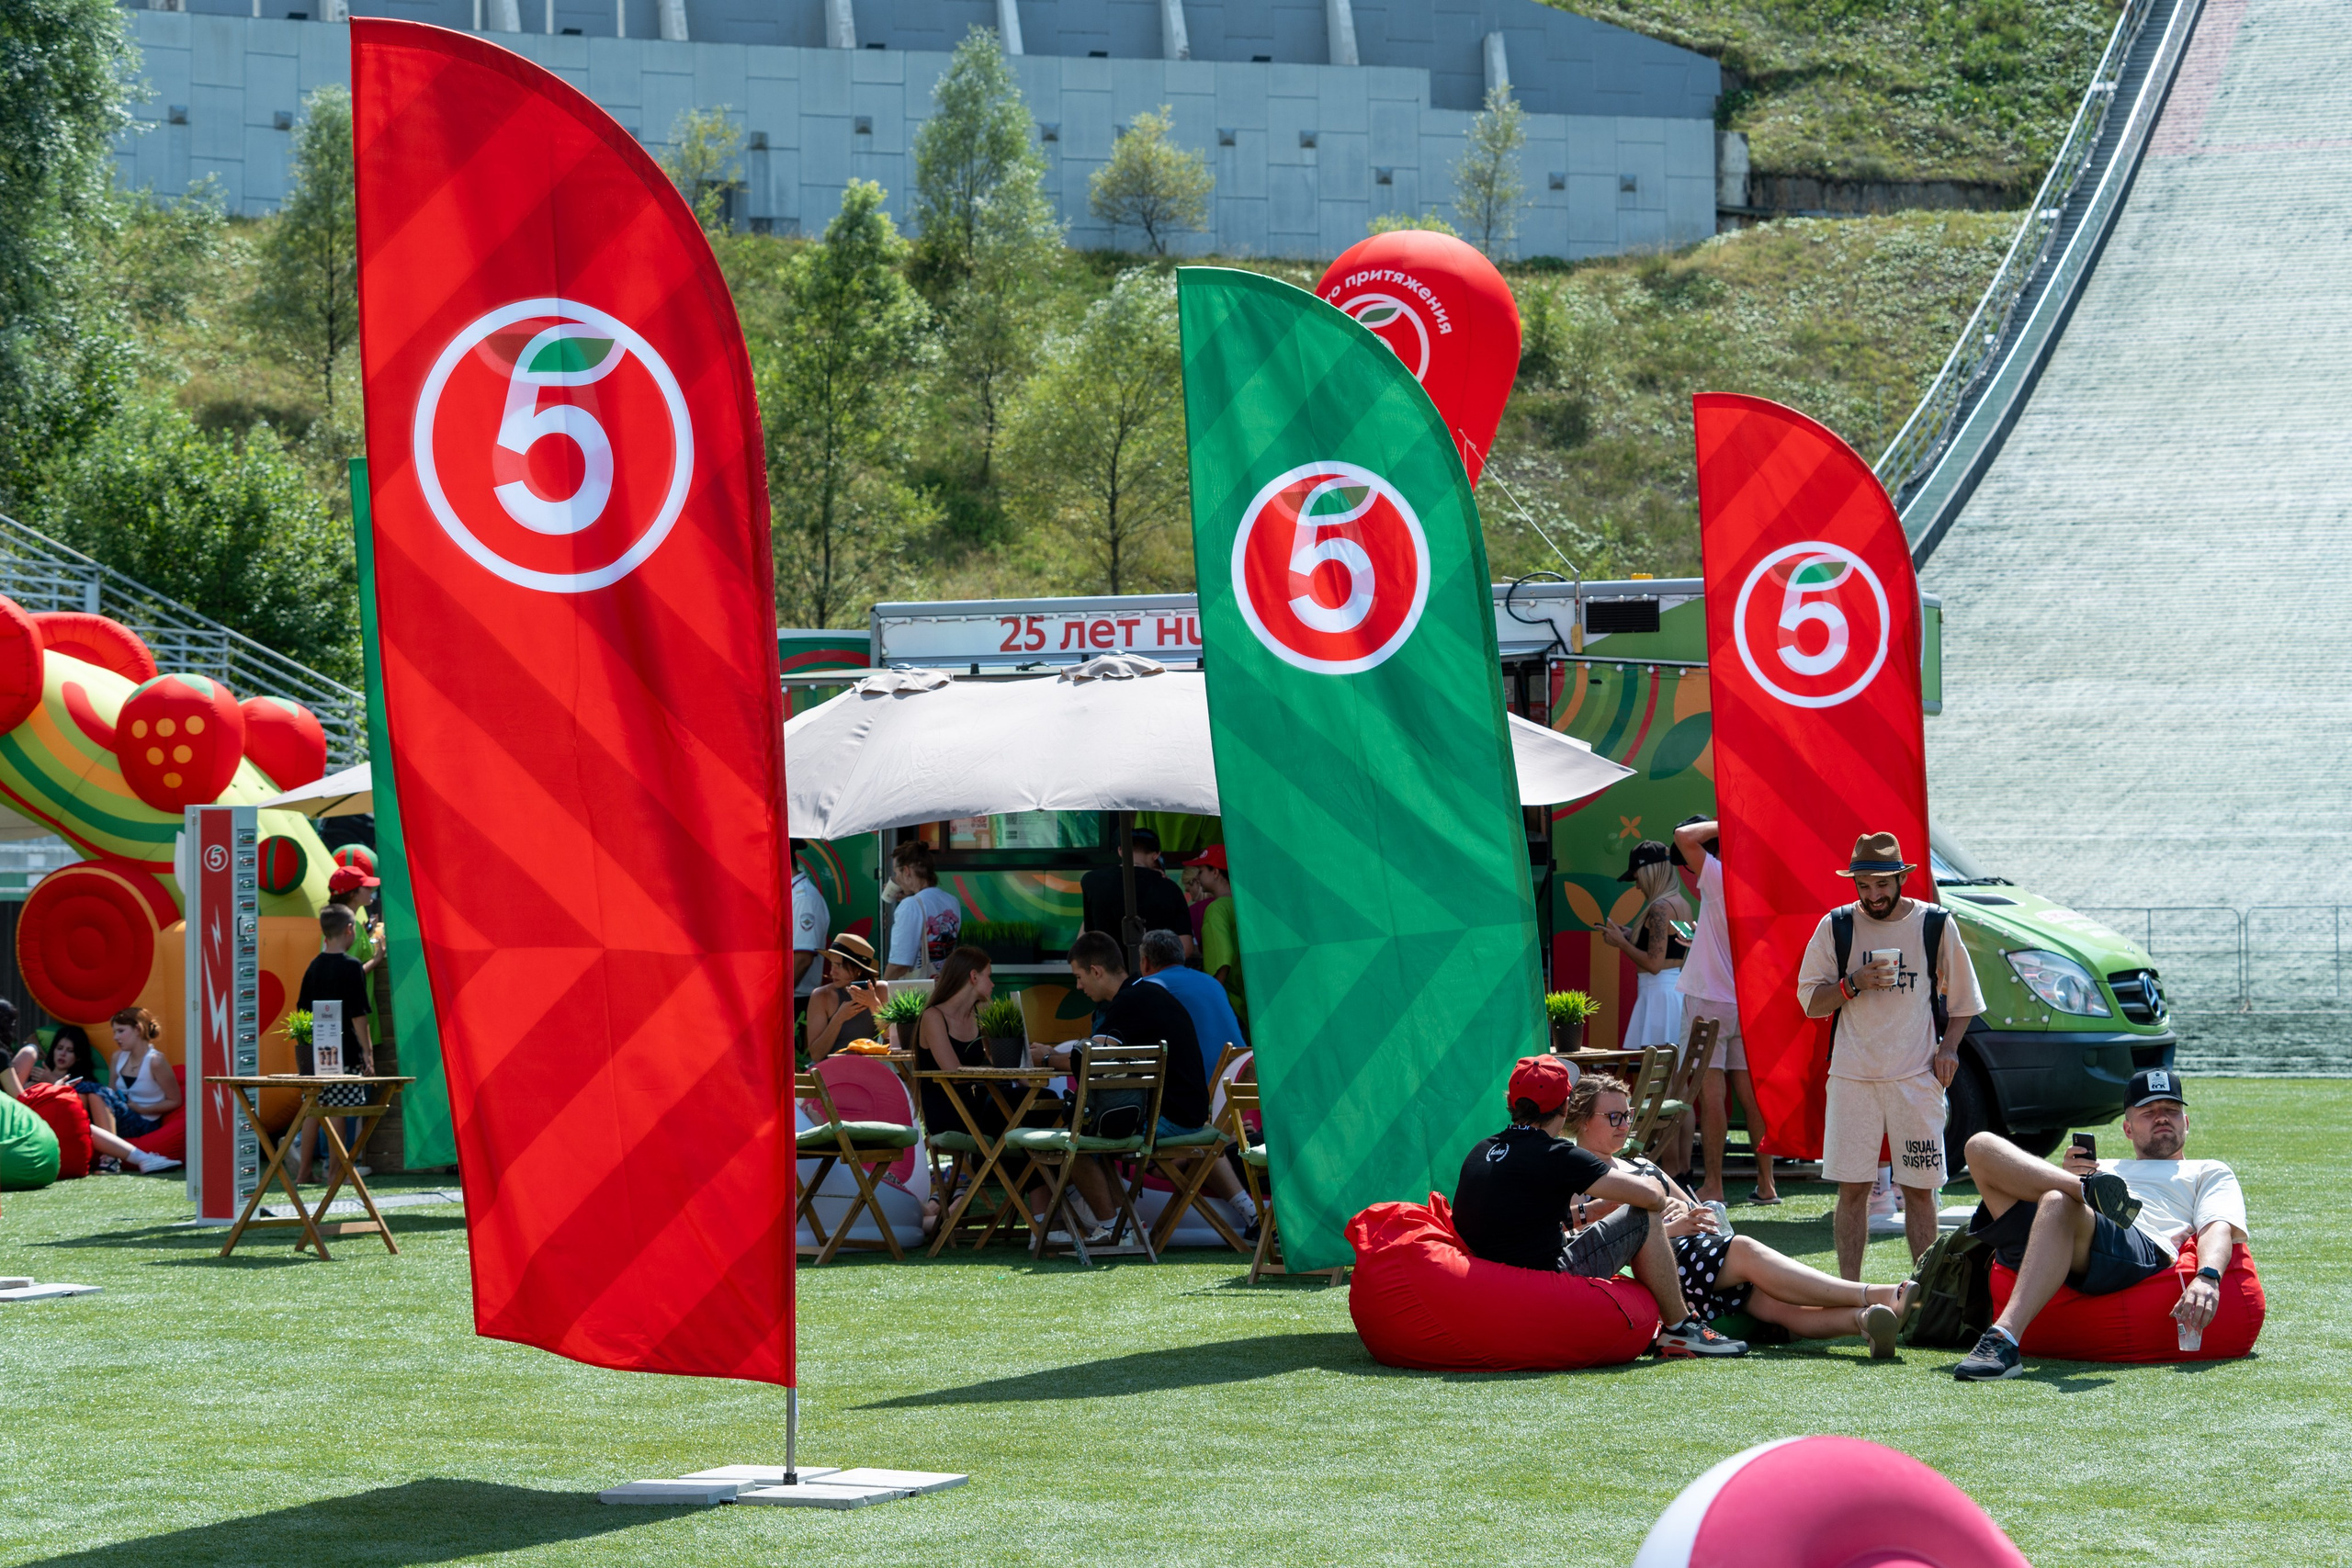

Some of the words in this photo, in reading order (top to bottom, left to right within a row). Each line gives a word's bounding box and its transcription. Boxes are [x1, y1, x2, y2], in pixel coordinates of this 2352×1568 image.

[1345, 269, 1453, 335] притяжения
[493, 322, 628, 536] 5
[1288, 477, 1379, 634] 5
[1000, 615, 1046, 652] 25
[1059, 618, 1141, 650] лет
[1777, 554, 1855, 676] 5
[1902, 1153, 1943, 1171] SUSPECT
[1905, 1139, 1938, 1155] USUAL
